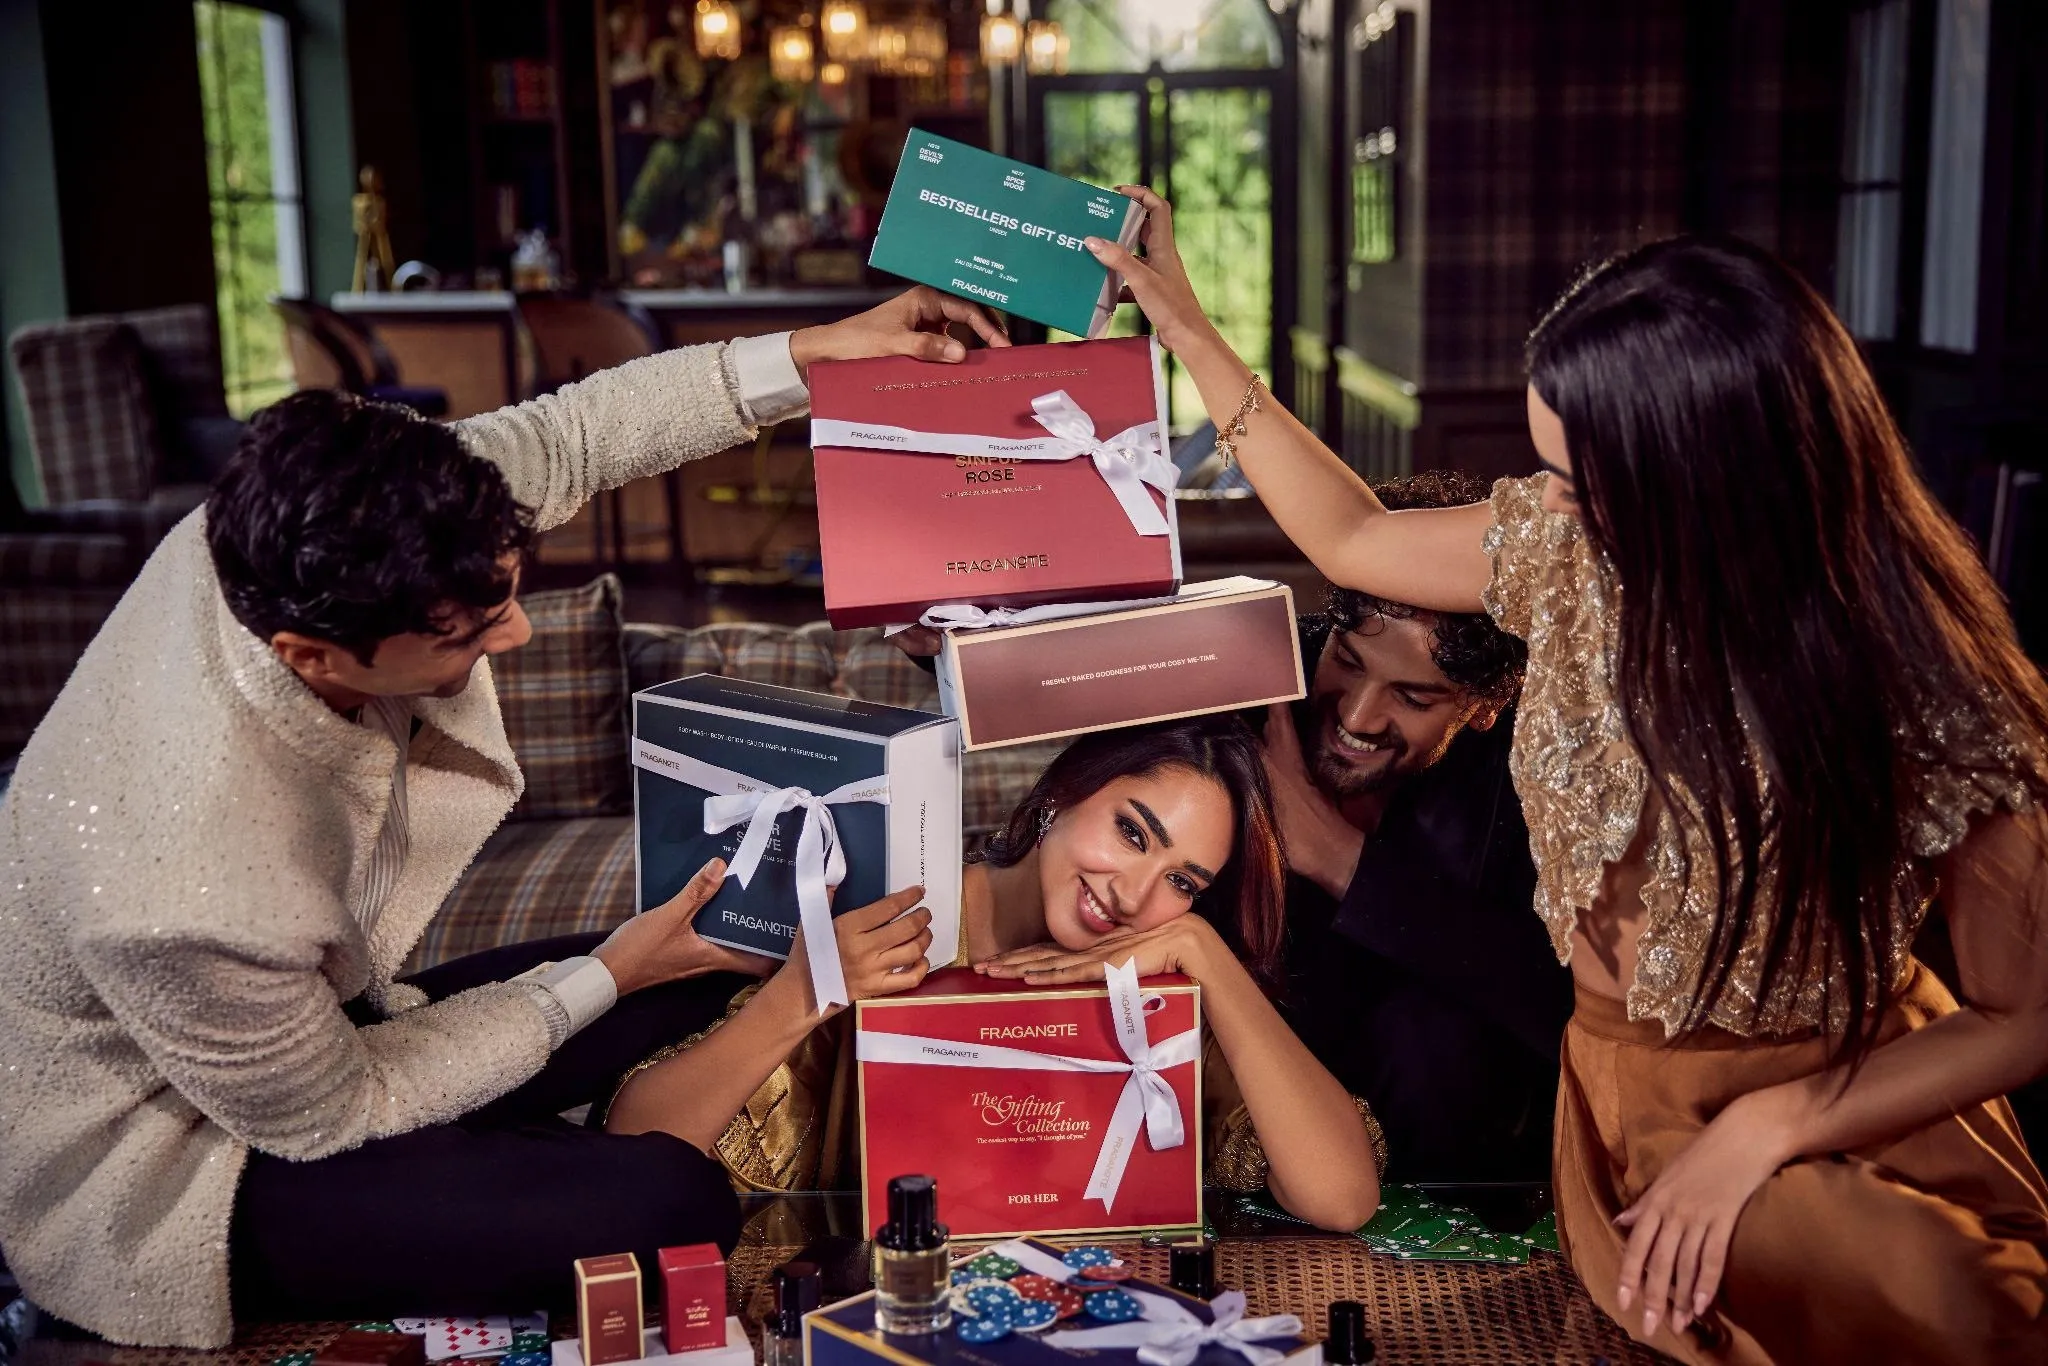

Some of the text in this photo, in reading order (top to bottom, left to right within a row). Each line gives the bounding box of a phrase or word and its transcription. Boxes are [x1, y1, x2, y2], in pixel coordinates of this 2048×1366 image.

[919, 147, 944, 160] DEVIL'S
[919, 153, 941, 165] BERRY
[1003, 181, 1024, 192] WOOD
[1005, 175, 1026, 186] SPICE
[1087, 201, 1115, 215] VANILLA
[1088, 207, 1109, 219] WOOD
[919, 189, 1084, 252] BESTSELLERS GIFT SET
[991, 260, 1005, 271] TRIO
[951, 278, 1009, 304] FRAGANOTE
[850, 431, 908, 443] FRAGANOTE
[965, 468, 1015, 484] ROSE
[946, 554, 1050, 575] FRAGANOTE
[1041, 676, 1071, 687] FRESHLY
[1072, 673, 1095, 682] BAKED
[1095, 666, 1132, 678] GOODNESS
[1133, 664, 1147, 673] FOR
[1148, 661, 1166, 670] YOUR
[1167, 658, 1186, 667] COSY
[710, 732, 725, 740] BODY
[640, 750, 680, 771] FRAGANOTE
[722, 910, 797, 939] FRAGANOTE
[980, 1023, 1078, 1040] FRAGANOTE
[921, 1046, 979, 1059] FRAGANOTE
[971, 1091, 1066, 1126] The Gifting
[1016, 1117, 1091, 1134] Collection
[1043, 1133, 1066, 1142] thought
[1008, 1193, 1059, 1205] FOR HER
